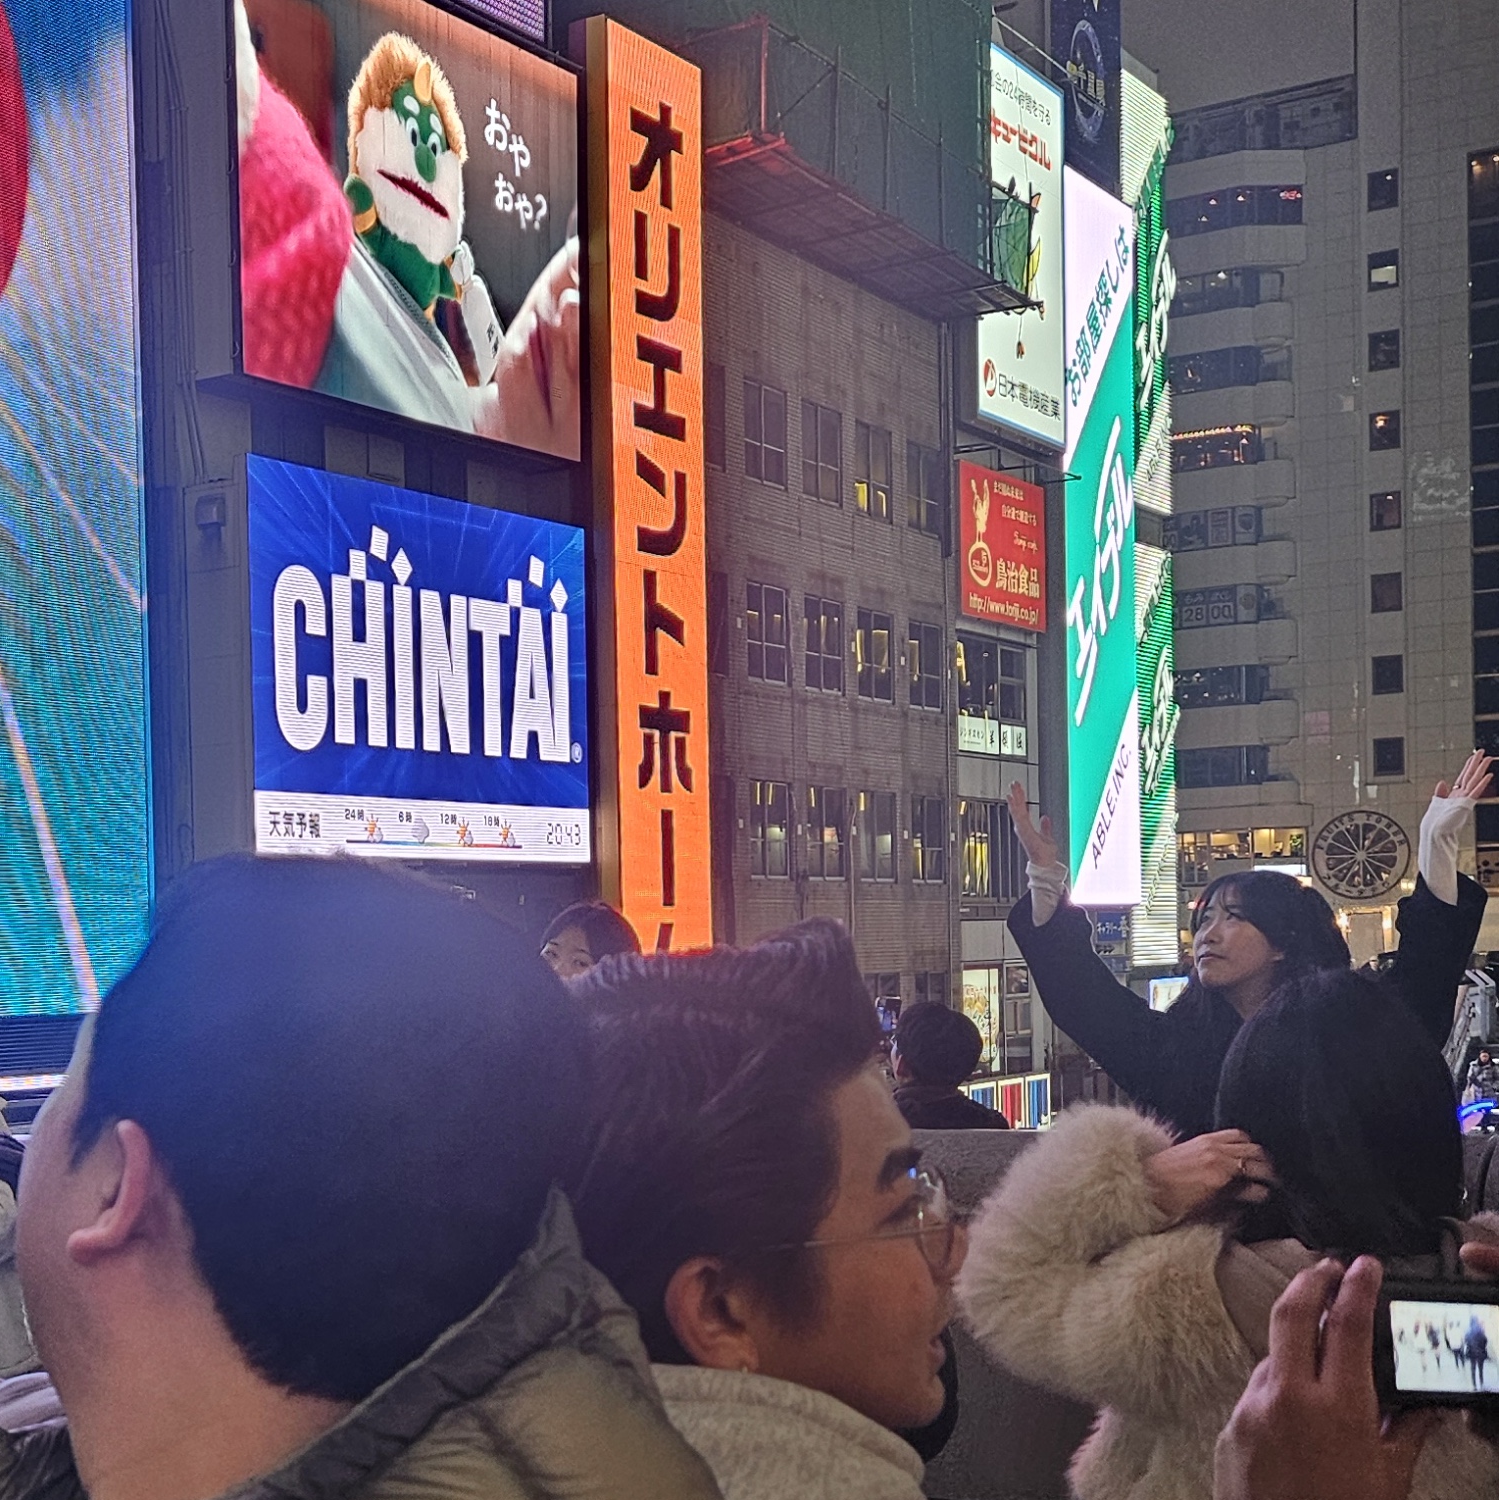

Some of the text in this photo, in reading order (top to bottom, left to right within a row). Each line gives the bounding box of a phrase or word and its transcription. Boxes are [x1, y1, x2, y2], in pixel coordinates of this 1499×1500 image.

[484, 97, 531, 178] おや
[273, 525, 571, 764] CHINTAI
[1067, 414, 1135, 728] エイブル
[267, 810, 322, 839] 天気予報
